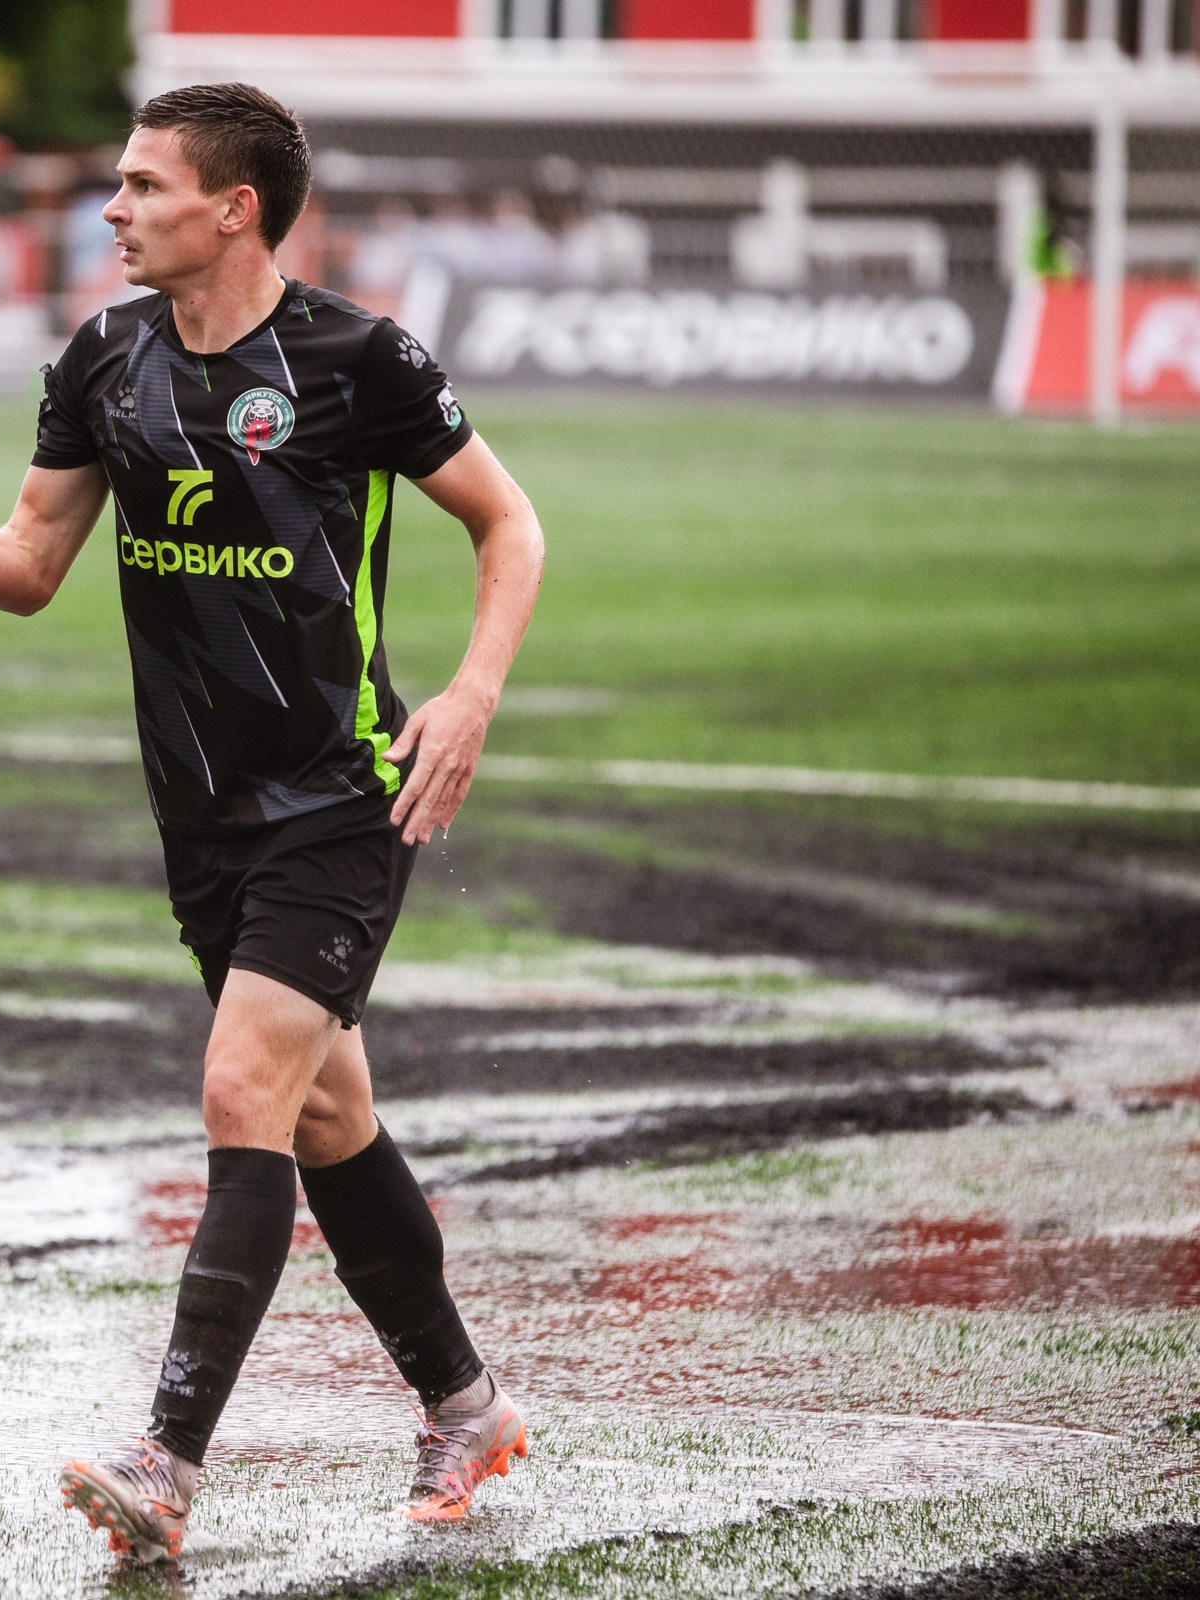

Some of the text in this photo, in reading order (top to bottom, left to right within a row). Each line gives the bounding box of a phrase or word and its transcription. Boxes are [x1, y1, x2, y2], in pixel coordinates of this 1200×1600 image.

[245, 391, 284, 405] ИРКУТСК
[109, 408, 138, 419] KELM
[120, 534, 294, 579] сервико
